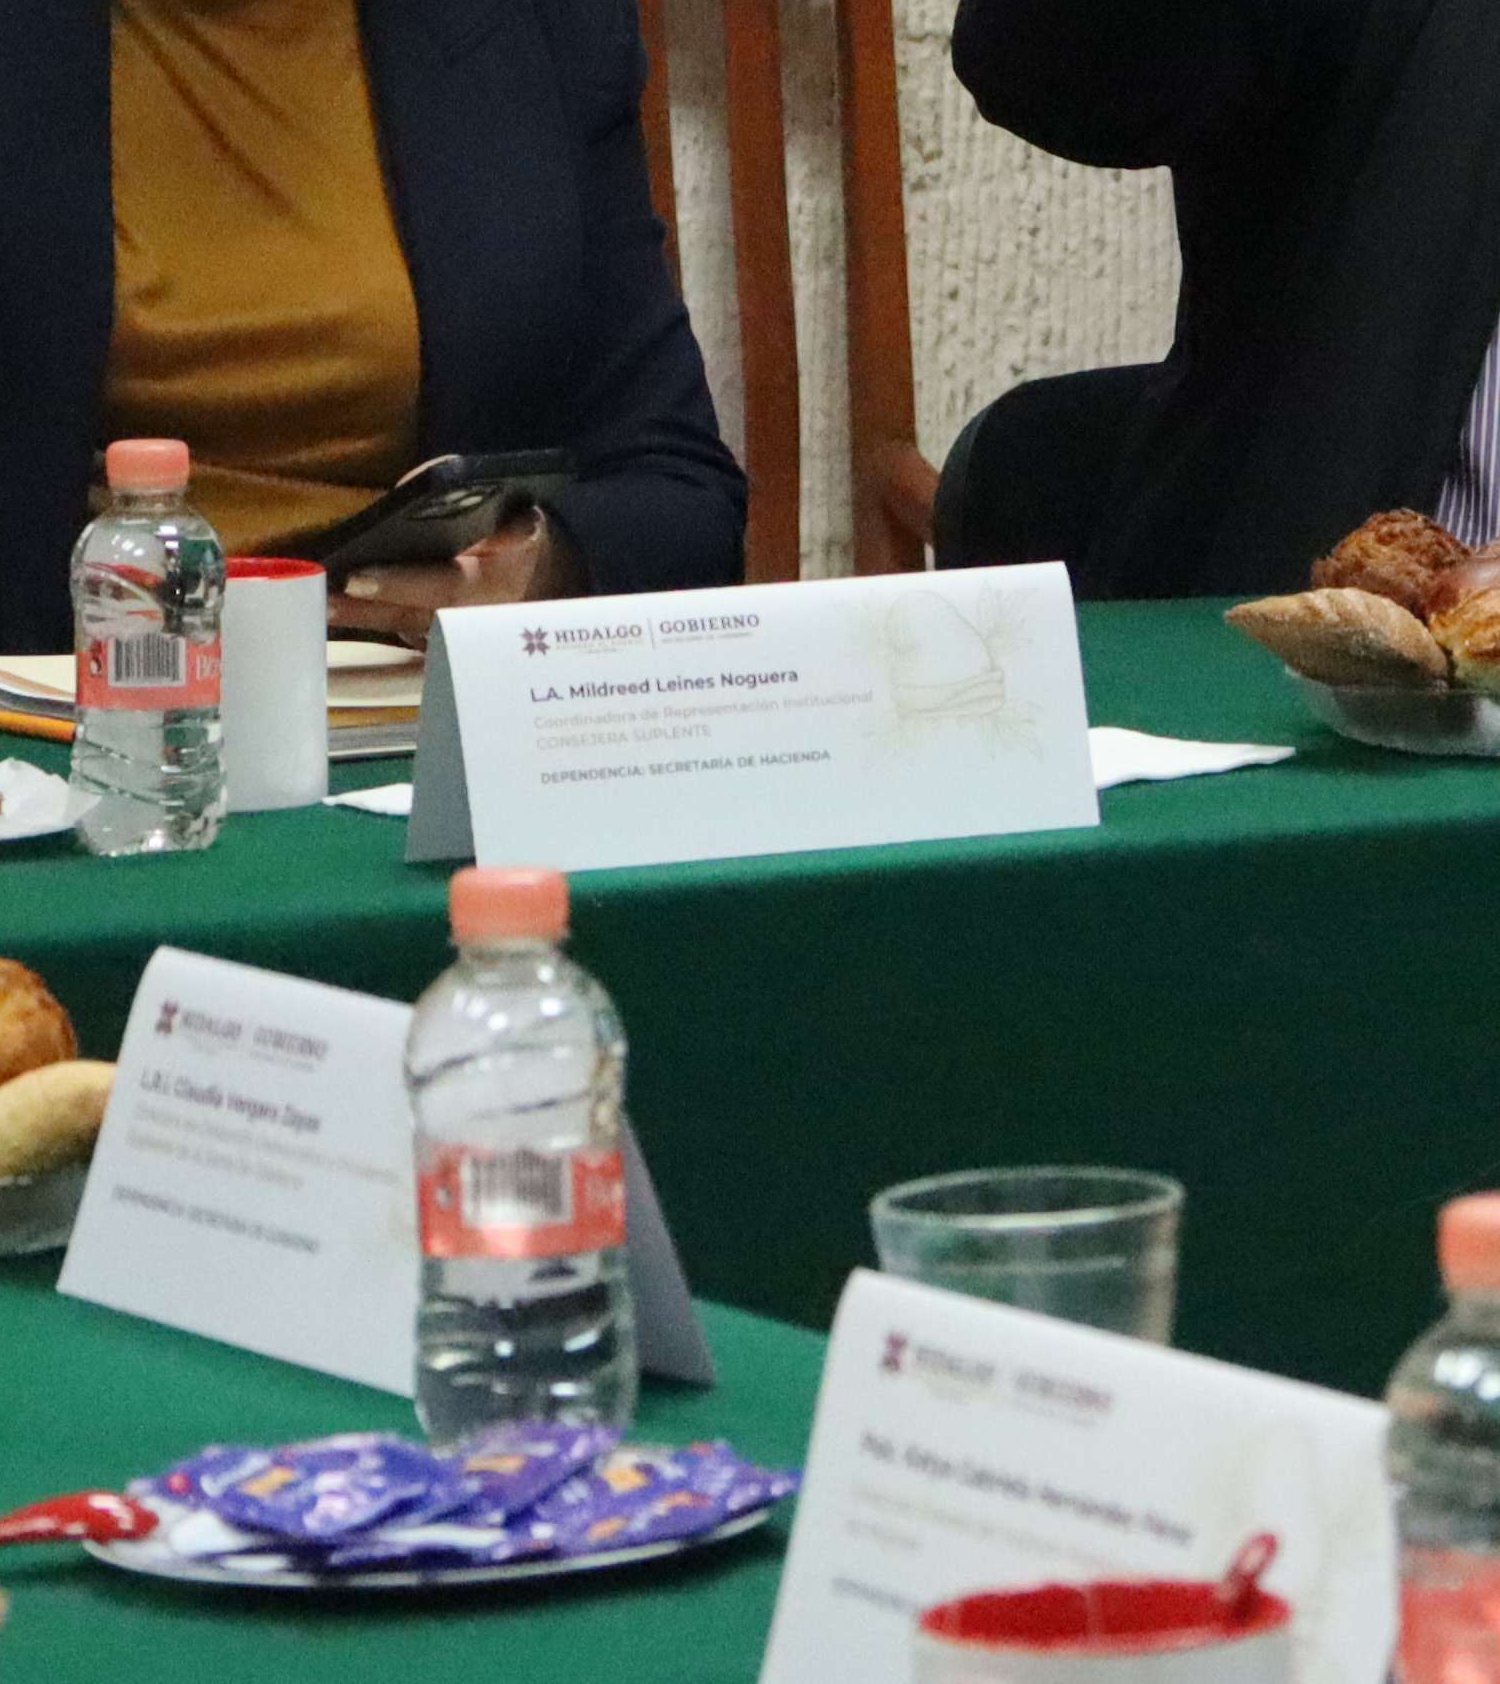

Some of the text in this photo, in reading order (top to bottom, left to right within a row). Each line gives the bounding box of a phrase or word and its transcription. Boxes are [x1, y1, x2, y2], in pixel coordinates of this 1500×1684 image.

[553, 624, 643, 643] HIDALGO
[658, 614, 760, 635] GOBIERNO
[569, 678, 651, 700] Mildreed
[655, 673, 715, 694] Leines
[720, 668, 800, 692] Noguera
[639, 707, 660, 722] de
[540, 764, 646, 785] DEPENDENCIA:
[737, 755, 757, 770] DE
[759, 749, 831, 767] HACIENDA
